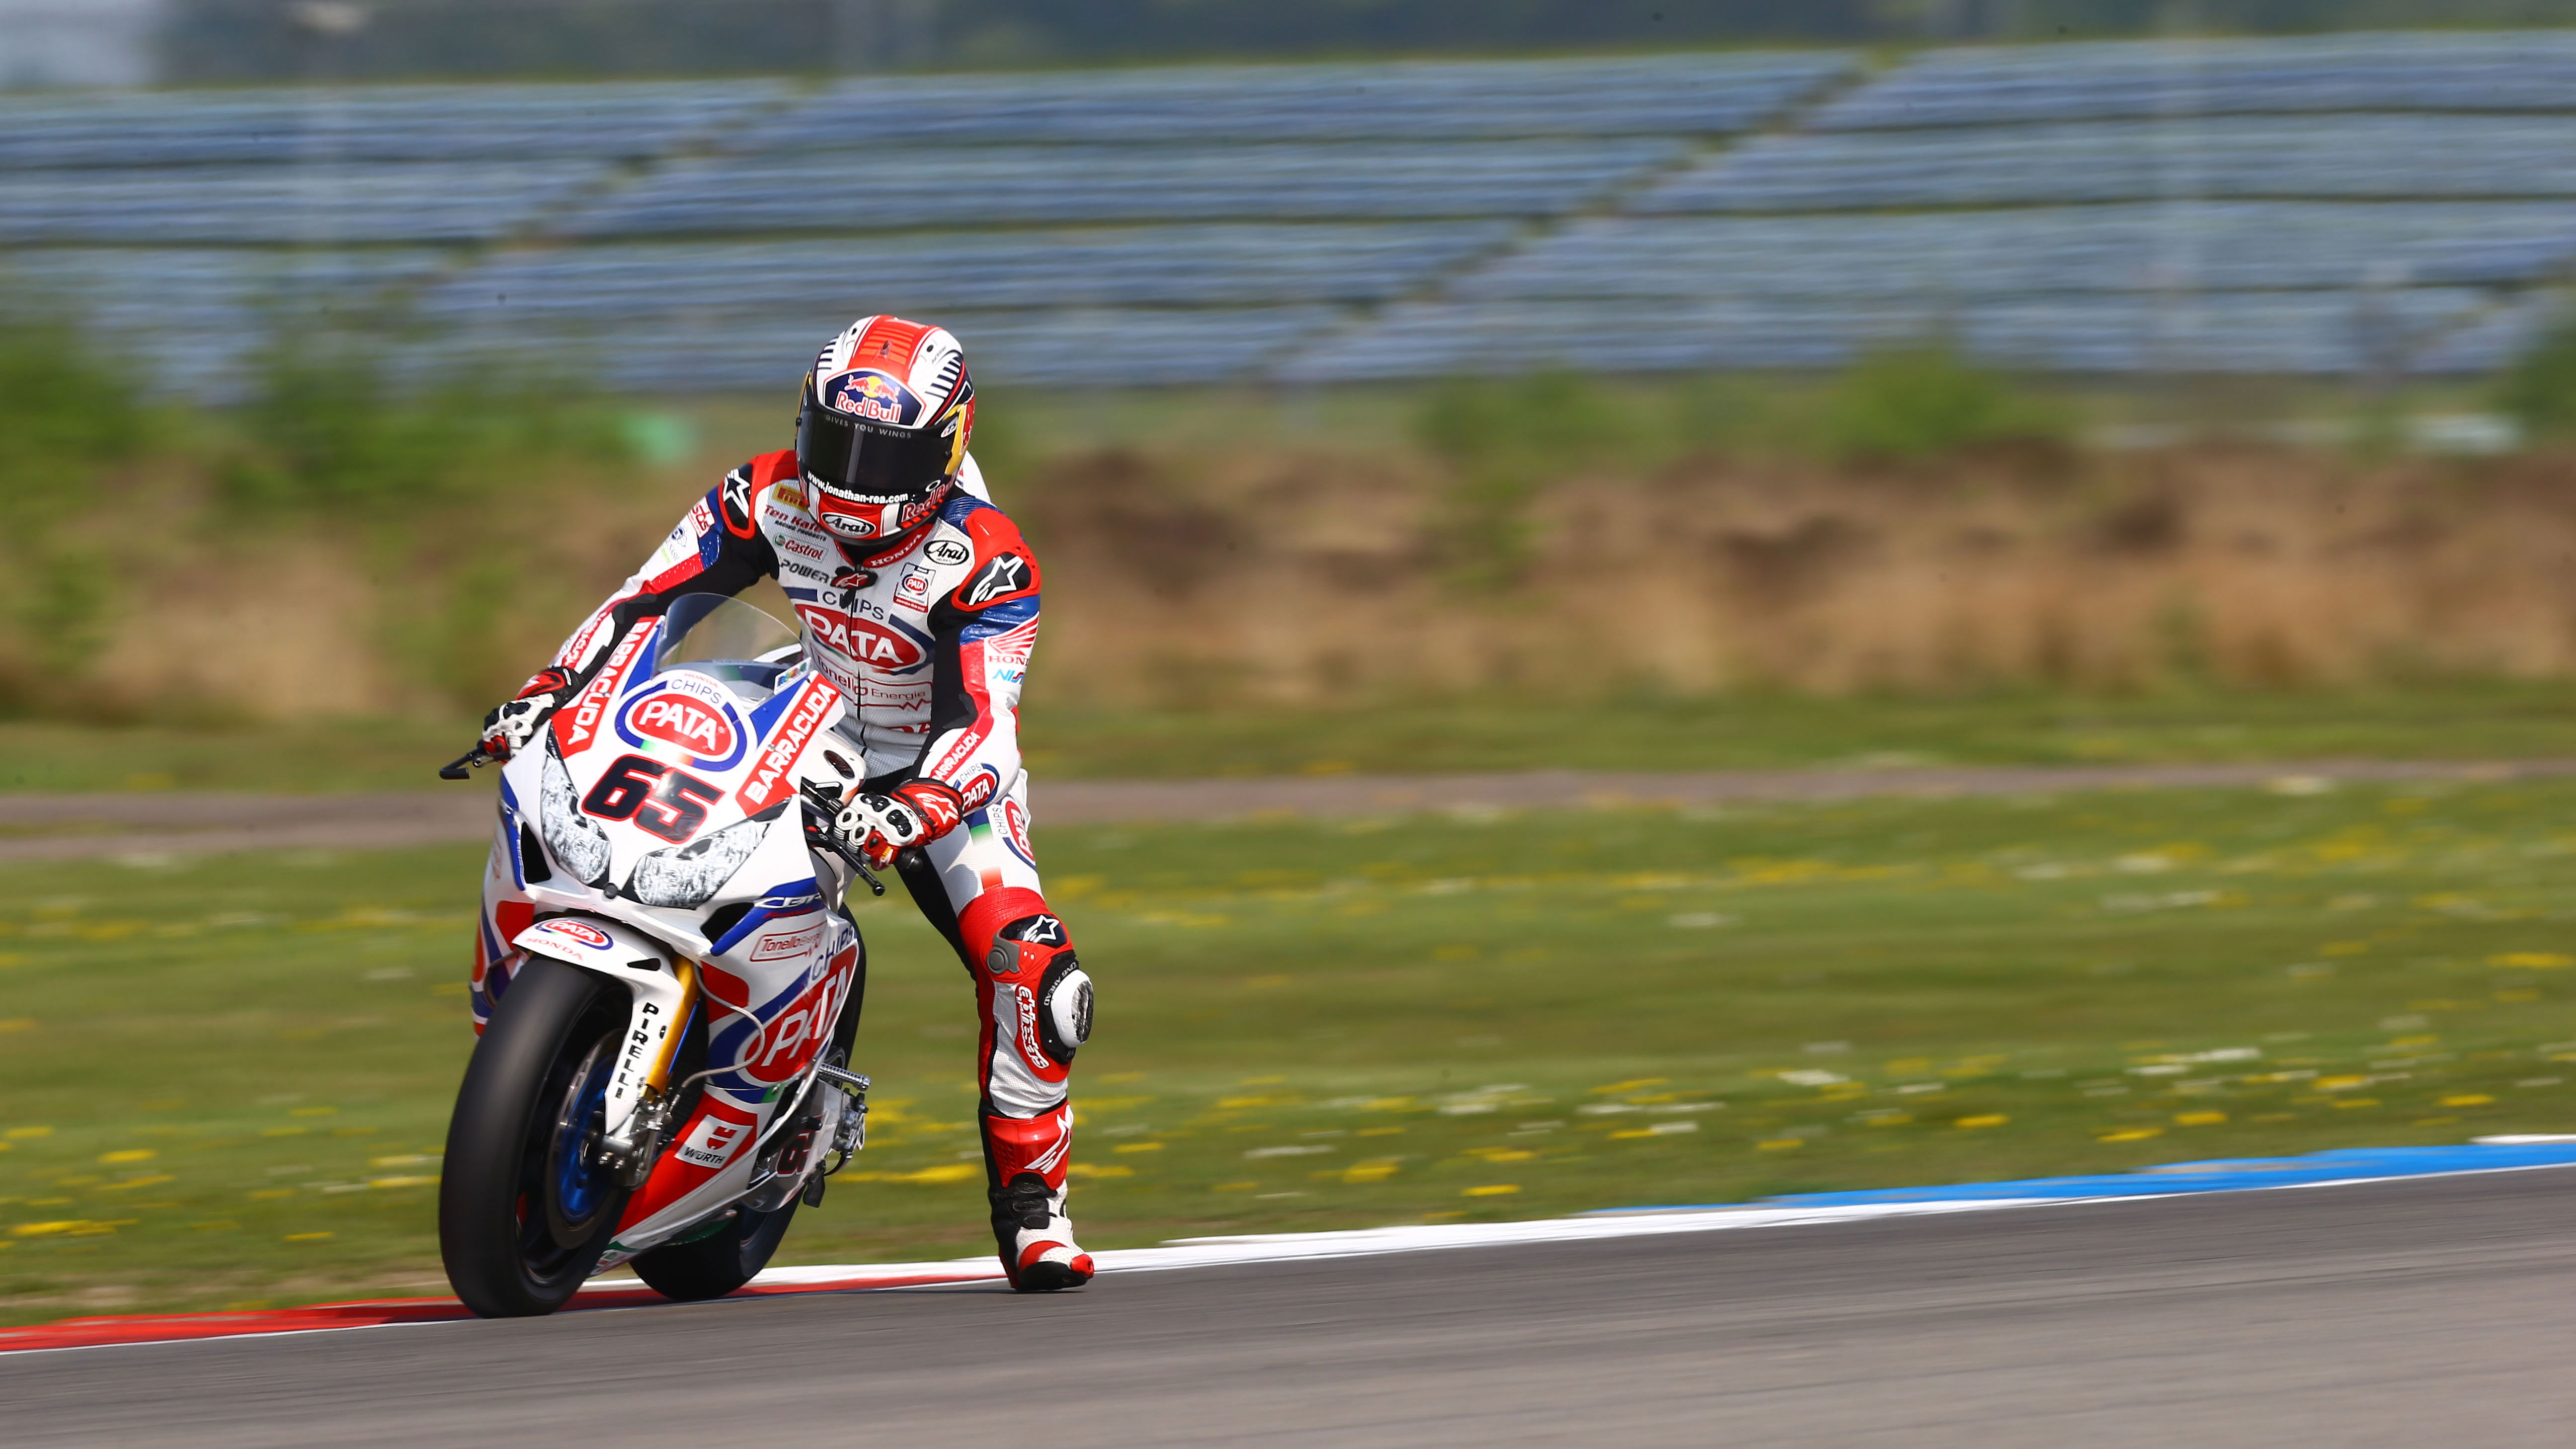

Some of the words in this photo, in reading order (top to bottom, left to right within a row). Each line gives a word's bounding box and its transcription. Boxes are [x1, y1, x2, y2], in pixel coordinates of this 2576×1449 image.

[867, 398, 901, 422] Bull
[825, 415, 848, 427] GIVES
[854, 422, 874, 432] YOU
[879, 428, 912, 439] WINGS
[807, 470, 908, 504] www.jonathan-rea.com
[764, 503, 789, 520] Ten
[827, 517, 869, 533] Arai
[784, 539, 824, 560] Castrol
[870, 533, 923, 567] HONDA
[927, 541, 966, 560] Arai
[907, 578, 924, 590] PATA
[805, 608, 904, 664] PATA
[671, 679, 722, 704] CHIPS
[872, 688, 926, 700] Energie
[639, 701, 718, 751] PATA
[744, 682, 837, 805] BARRACUDA
[960, 763, 982, 782] CHIPS
[581, 753, 725, 845] 65
[962, 778, 990, 811] PATA
[992, 807, 1008, 834] CHIPS
[1010, 808, 1033, 856] PATA
[550, 922, 597, 941] PATA
[525, 938, 584, 962] HONDA
[762, 936, 801, 952] Tonello
[812, 928, 854, 979] CHIPS
[761, 966, 848, 1066] PATA
[615, 1002, 659, 1099] PIRELLI
[684, 1147, 726, 1164] WÜRTH
